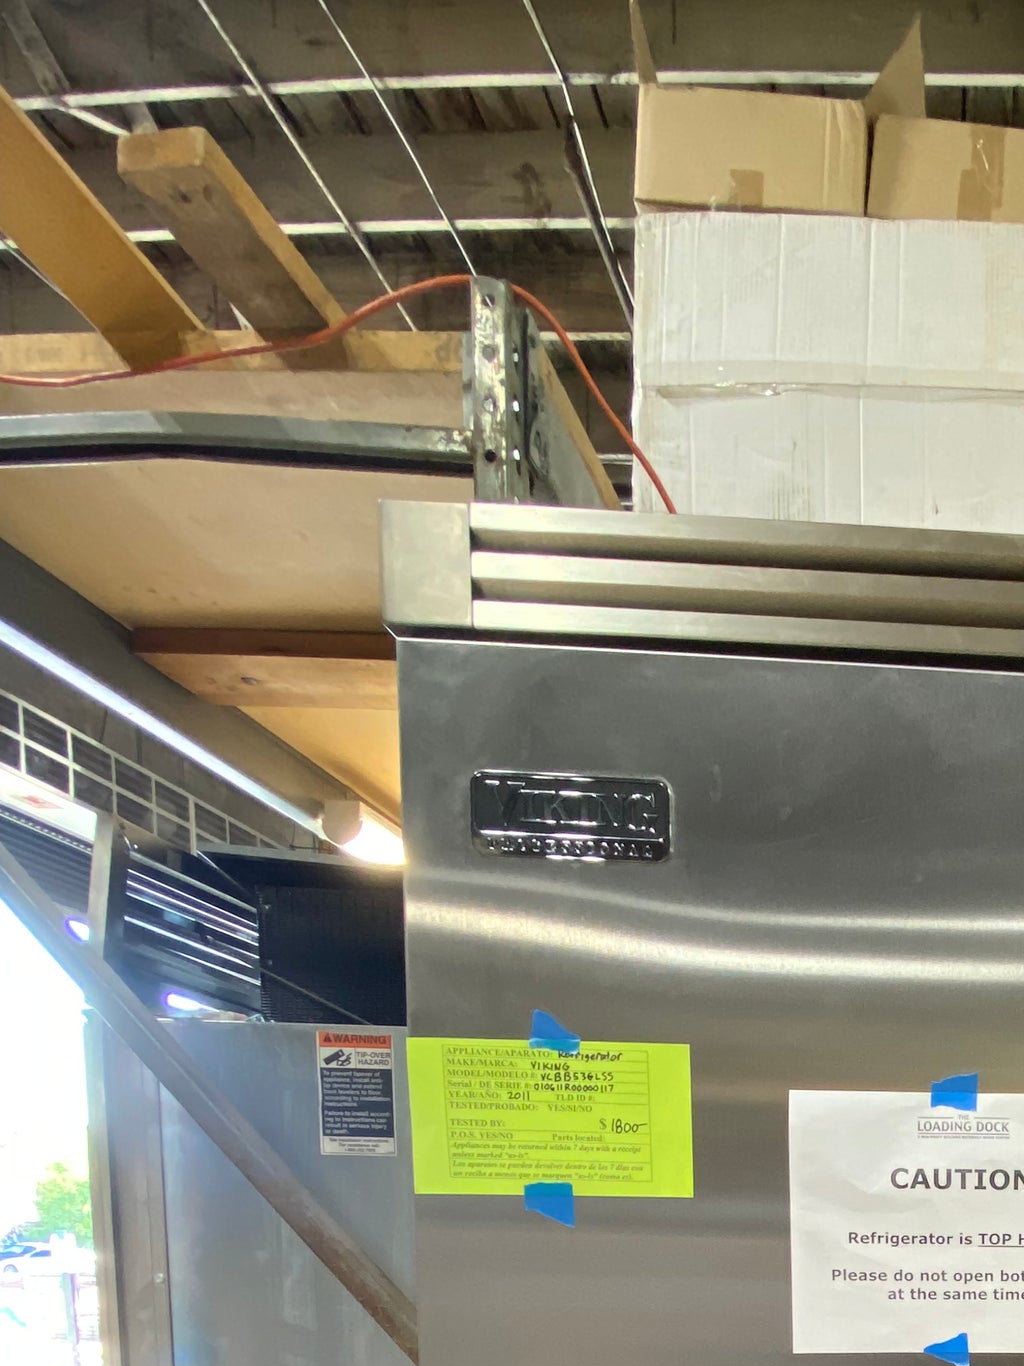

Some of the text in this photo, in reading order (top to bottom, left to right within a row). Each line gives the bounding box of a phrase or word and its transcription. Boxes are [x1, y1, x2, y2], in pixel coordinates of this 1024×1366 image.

[484, 779, 659, 833] VIKING
[333, 1033, 387, 1045] WARNING
[356, 1051, 391, 1059] TIP-OVER
[446, 1058, 518, 1067] MAKE/MARCA:
[530, 1060, 570, 1071] VIKING
[446, 1069, 528, 1078] MODEL/MODELO
[447, 1079, 472, 1088] Serial
[479, 1080, 492, 1088] DE
[494, 1081, 521, 1089] SERIE
[507, 1091, 530, 1101] 2011
[449, 1101, 539, 1111] TESTED/PROBADO:
[449, 1118, 507, 1127] TESTED BY:
[917, 1120, 1010, 1132] LOADING DOCK
[552, 1133, 573, 1141] Parts
[848, 1231, 953, 1247] Refrigerator
[959, 1232, 973, 1245] is
[978, 1233, 1012, 1245] TOP
[831, 1269, 888, 1282] Please
[893, 1269, 914, 1282] do
[920, 1271, 947, 1282] not
[953, 1271, 994, 1285] open
[888, 1289, 905, 1301] at
[910, 1287, 937, 1301] the
[943, 1290, 988, 1301] same
